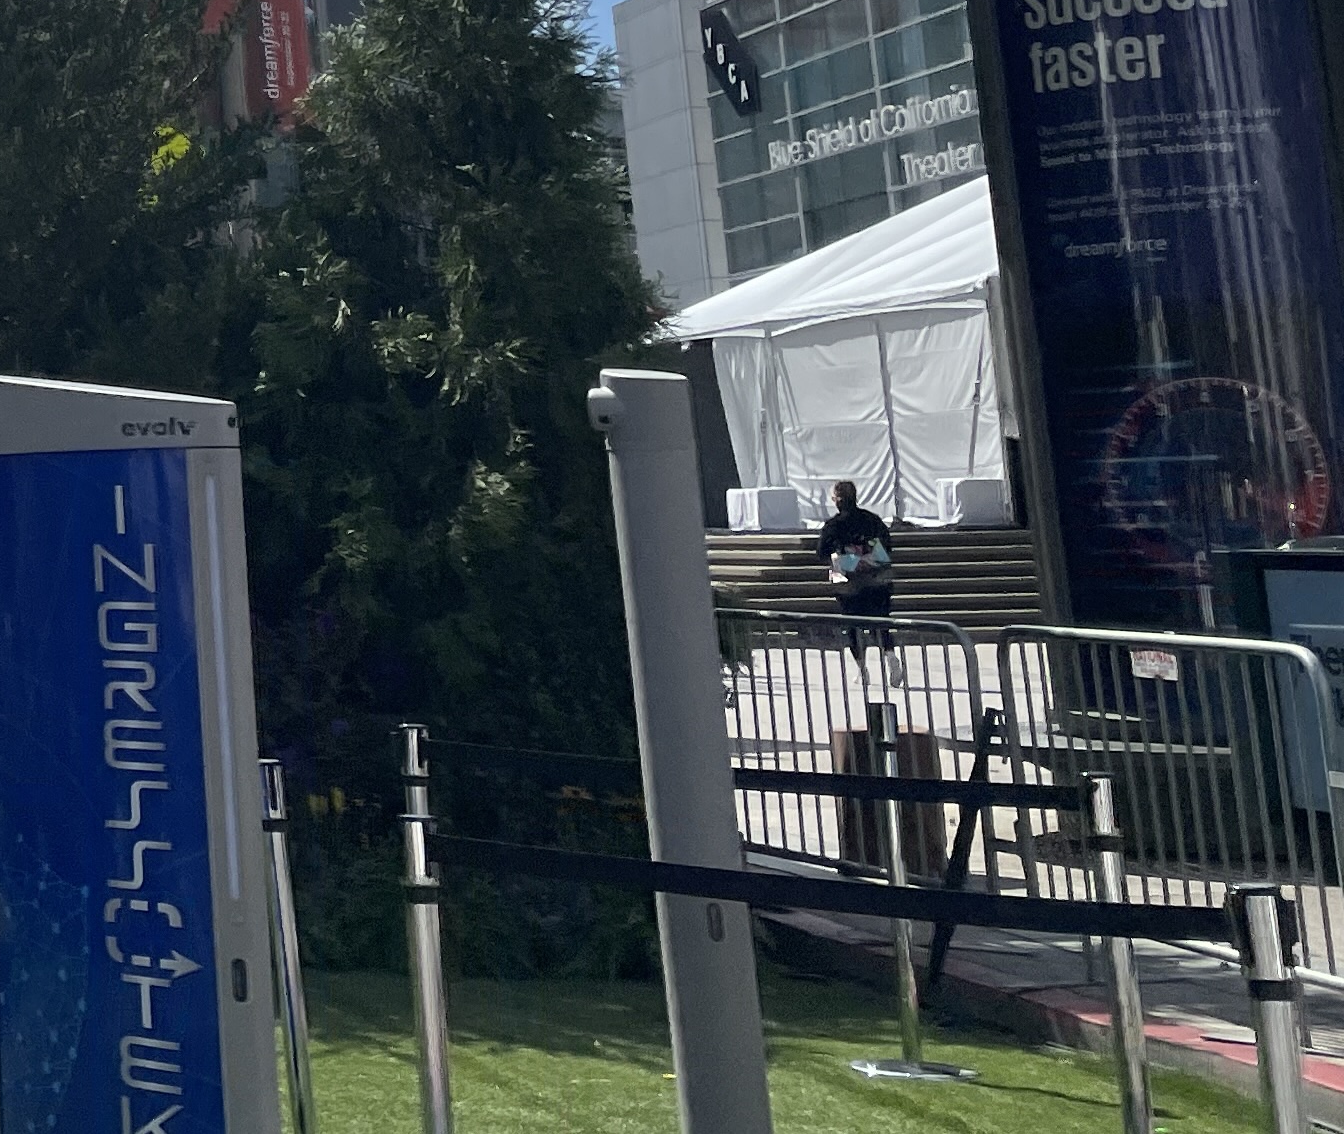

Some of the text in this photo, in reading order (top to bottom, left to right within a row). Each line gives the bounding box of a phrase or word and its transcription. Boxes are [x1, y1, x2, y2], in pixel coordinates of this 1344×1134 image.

[258, 1, 281, 99] dreamforce
[704, 27, 749, 103] YBCA
[1027, 33, 1165, 94] faster
[768, 84, 979, 170] Blue Shield of California
[900, 141, 984, 184] Theater
[120, 416, 198, 437] evolv
